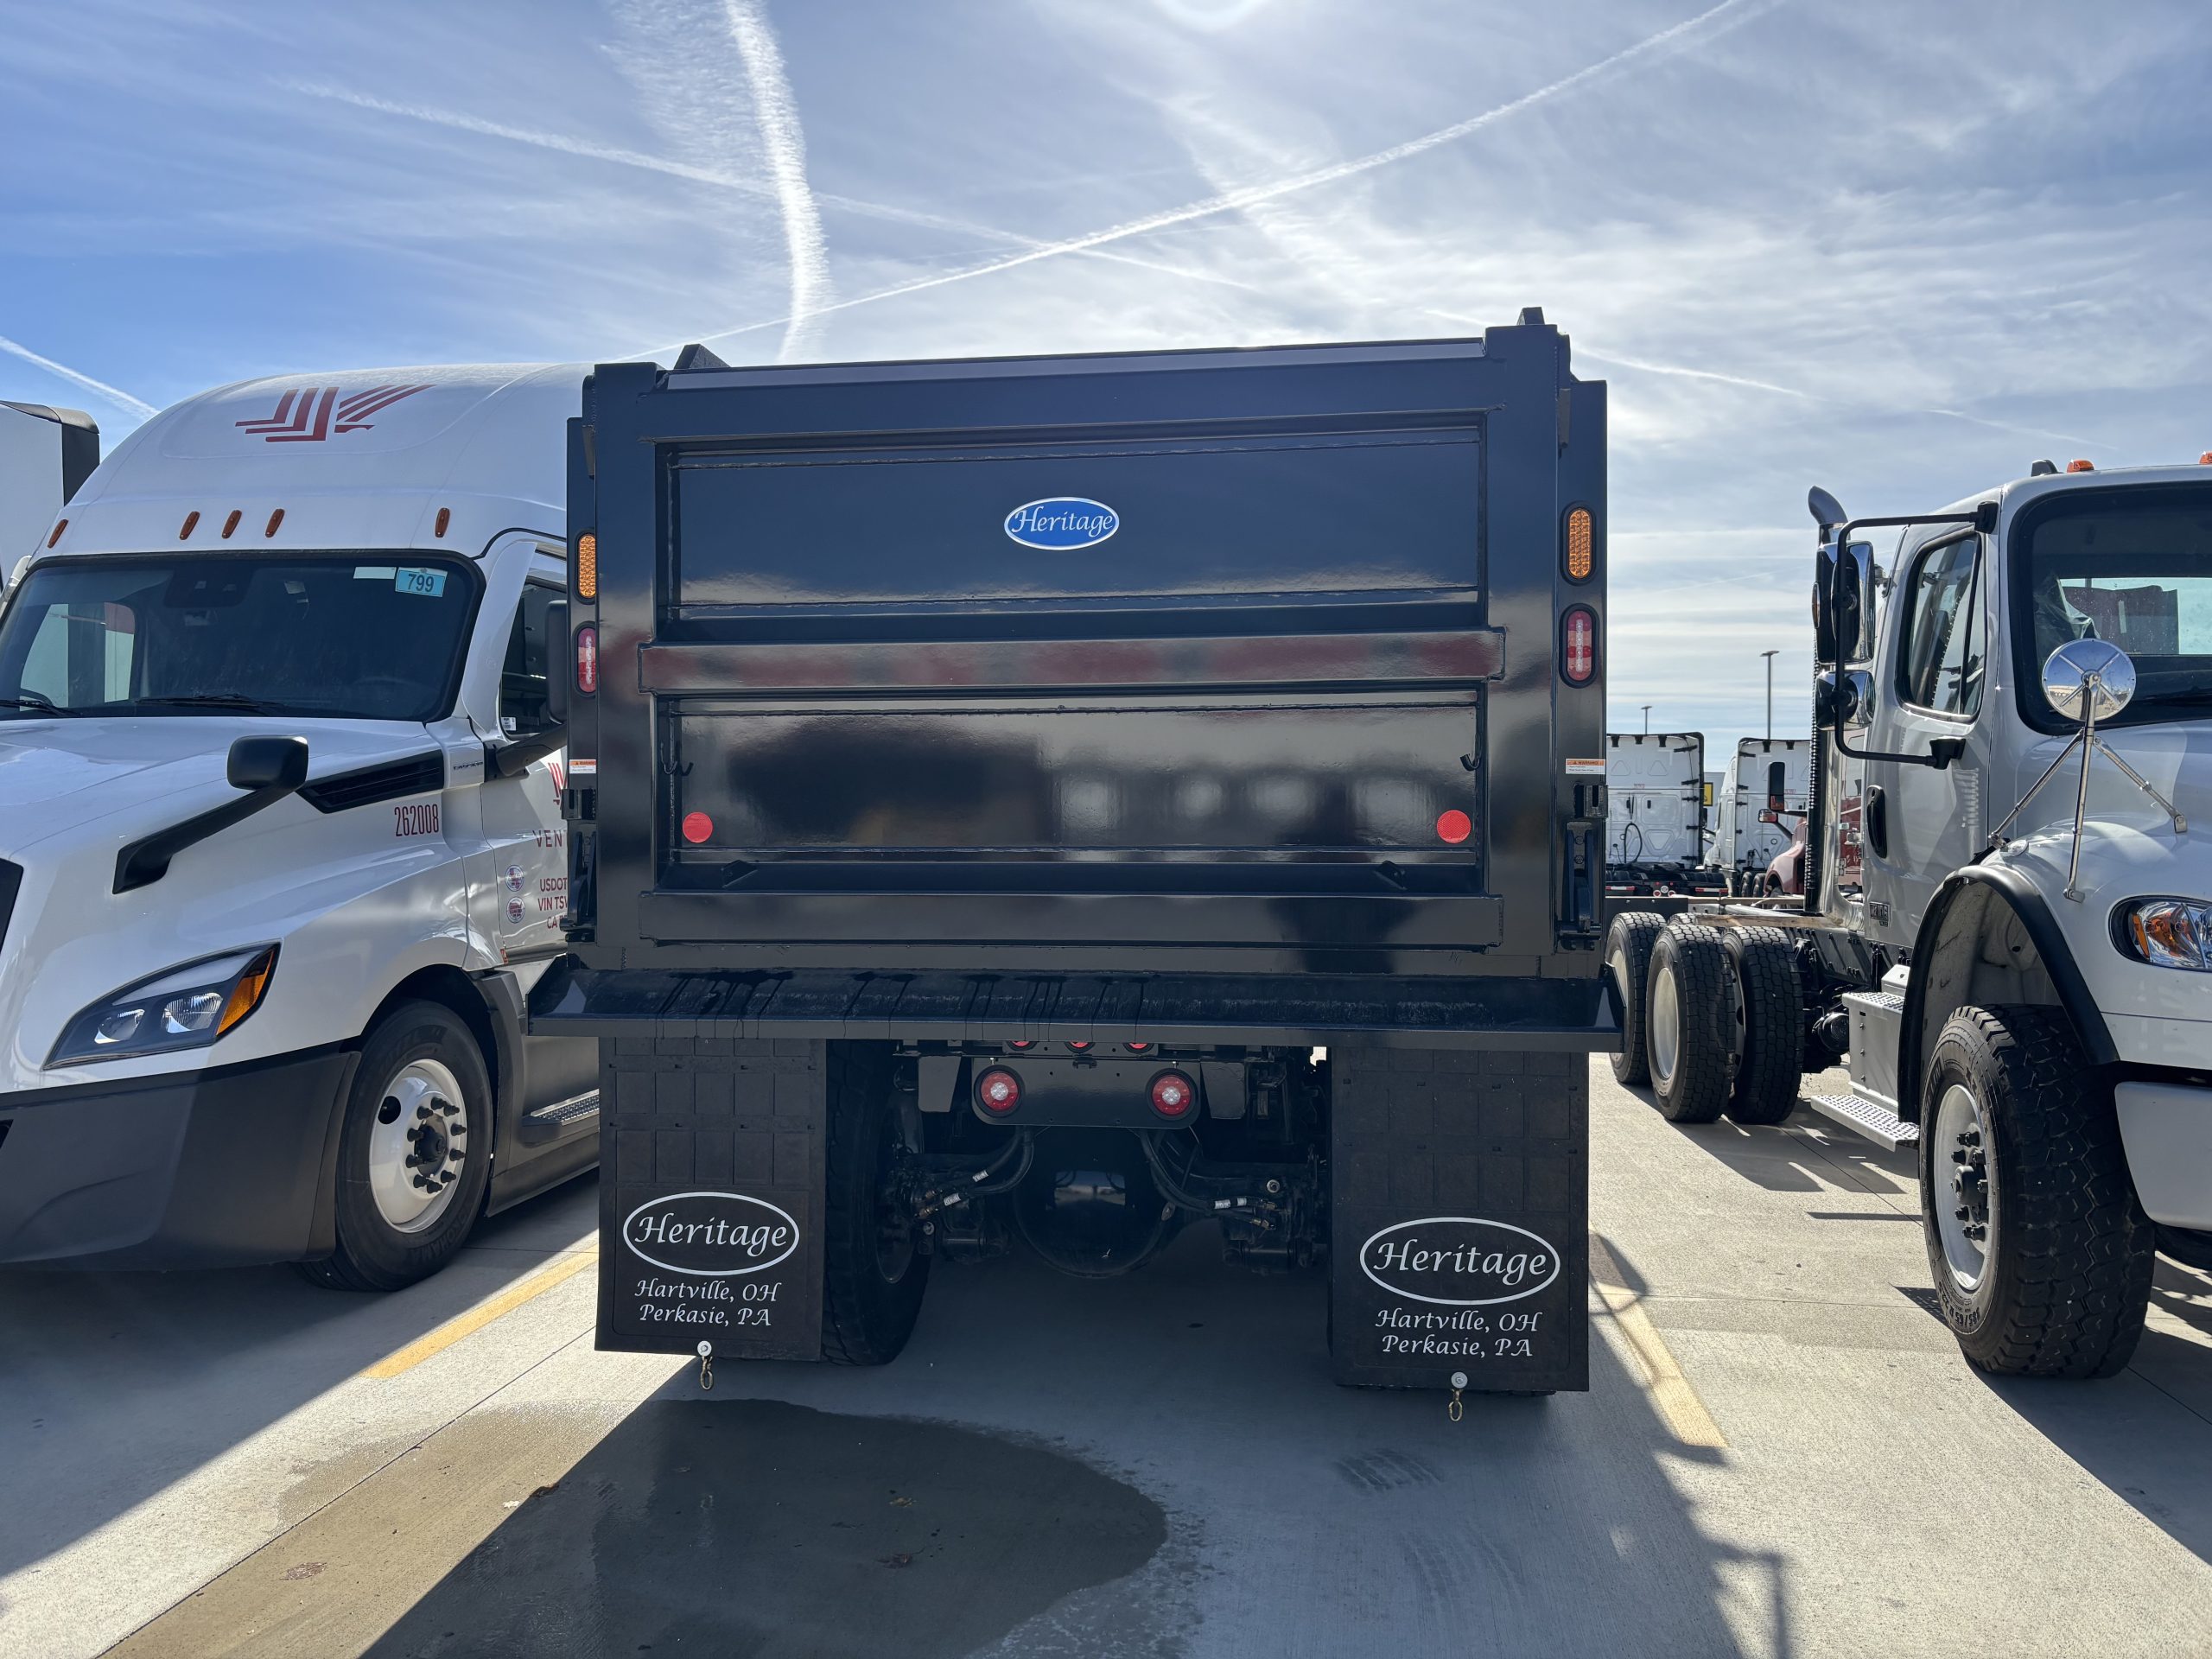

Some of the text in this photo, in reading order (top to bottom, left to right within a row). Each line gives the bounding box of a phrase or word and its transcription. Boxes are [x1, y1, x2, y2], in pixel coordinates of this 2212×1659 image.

[1011, 505, 1114, 537] Heritage
[408, 574, 435, 592] 799
[394, 804, 439, 837] 262008
[532, 830, 567, 848] VEN
[540, 877, 568, 892] USDOT
[537, 897, 553, 912] VIN
[634, 1212, 787, 1257] Heritage
[1373, 1238, 1547, 1286] Heritage
[634, 1277, 782, 1303] Hartville, OH
[639, 1303, 772, 1326] Perkasie, PA
[1375, 1307, 1542, 1332] Hartville, OH
[1382, 1333, 1533, 1358] Perkasie, PA
